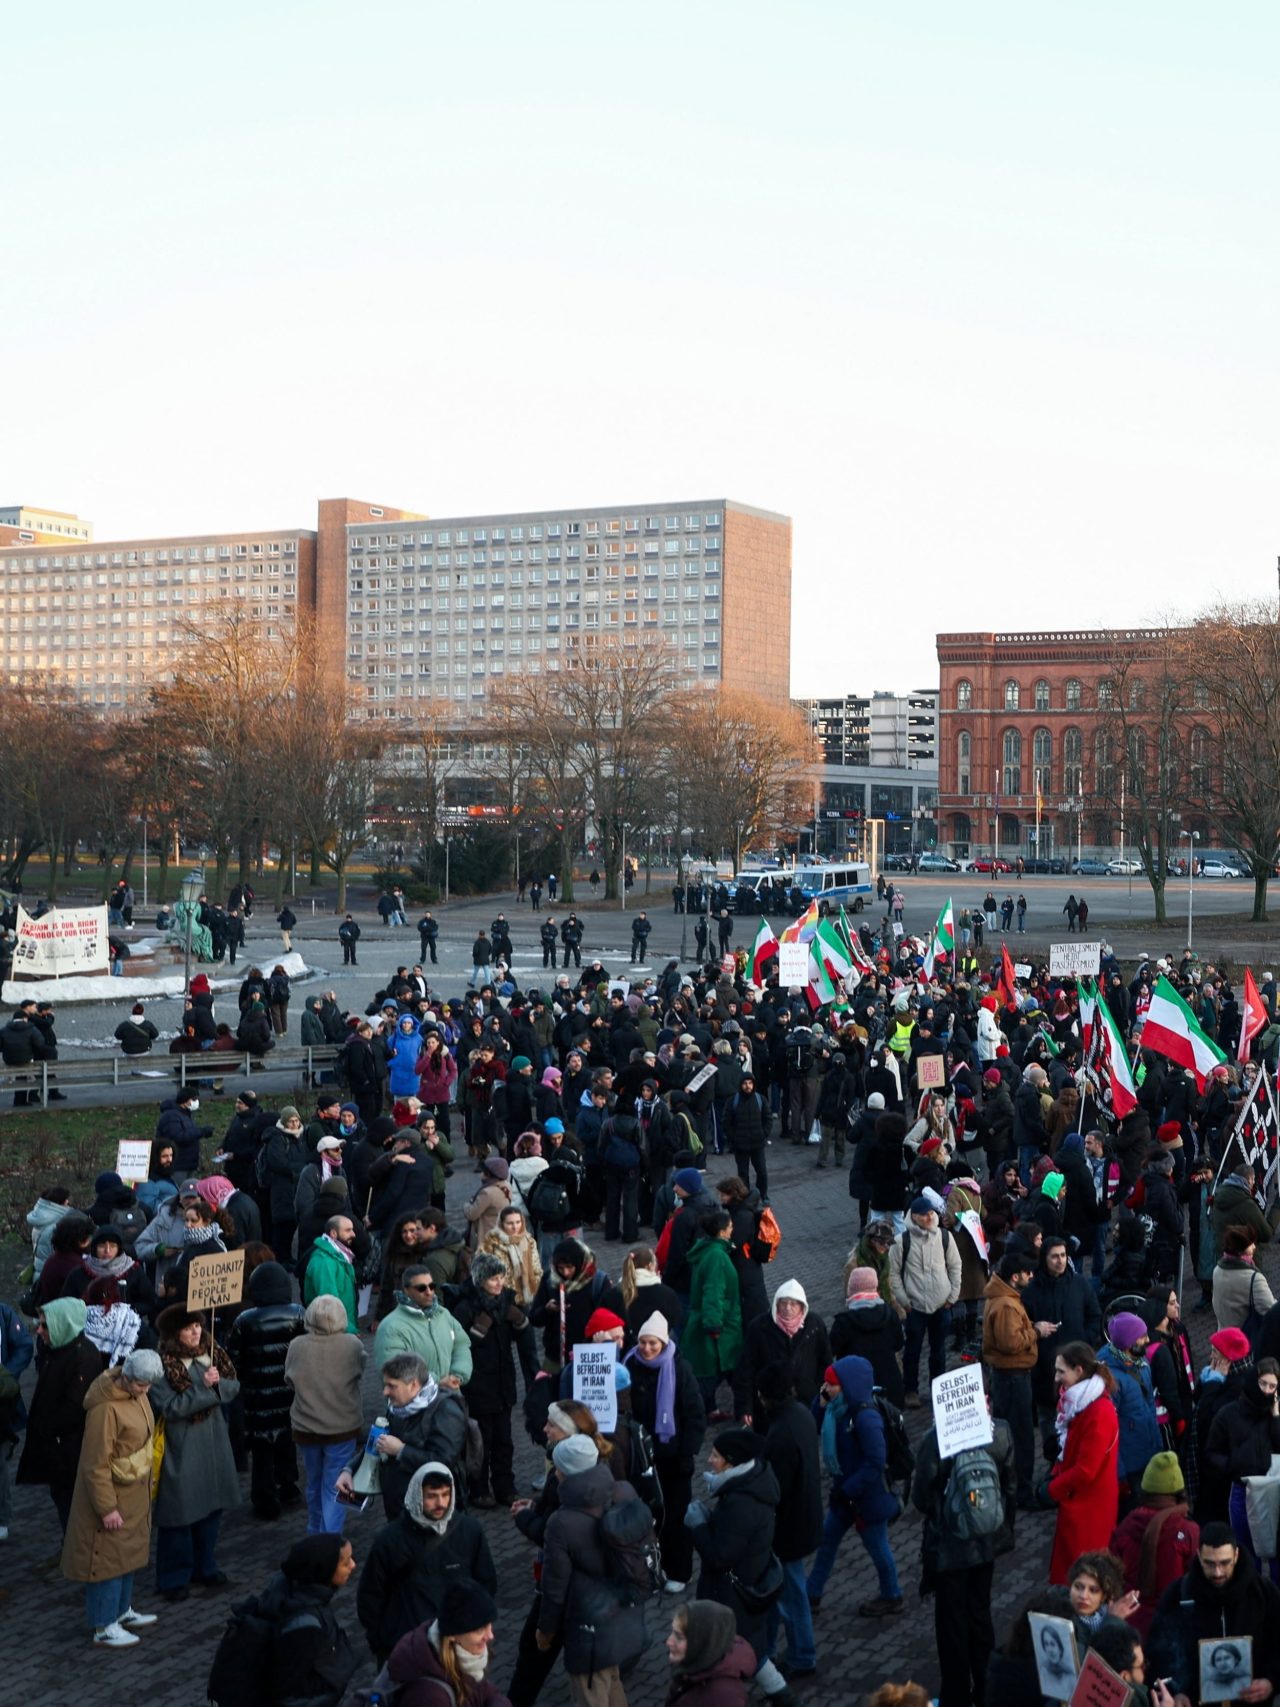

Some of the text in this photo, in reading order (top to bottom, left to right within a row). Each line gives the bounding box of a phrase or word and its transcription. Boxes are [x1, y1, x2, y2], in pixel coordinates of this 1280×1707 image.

[1051, 960, 1095, 969] FASCHISMUS
[191, 1260, 243, 1278] SOLIDARITY
[192, 1283, 226, 1300] PEOPLE
[203, 1293, 231, 1307] IRAN
[580, 1353, 608, 1363] SELBST-
[576, 1364, 611, 1375] BEFREIUNG
[582, 1376, 605, 1386] IM IRAN
[940, 1373, 974, 1392] SELBST-
[936, 1381, 980, 1405] BEFREIUNG
[945, 1394, 975, 1413] IM IRAN
